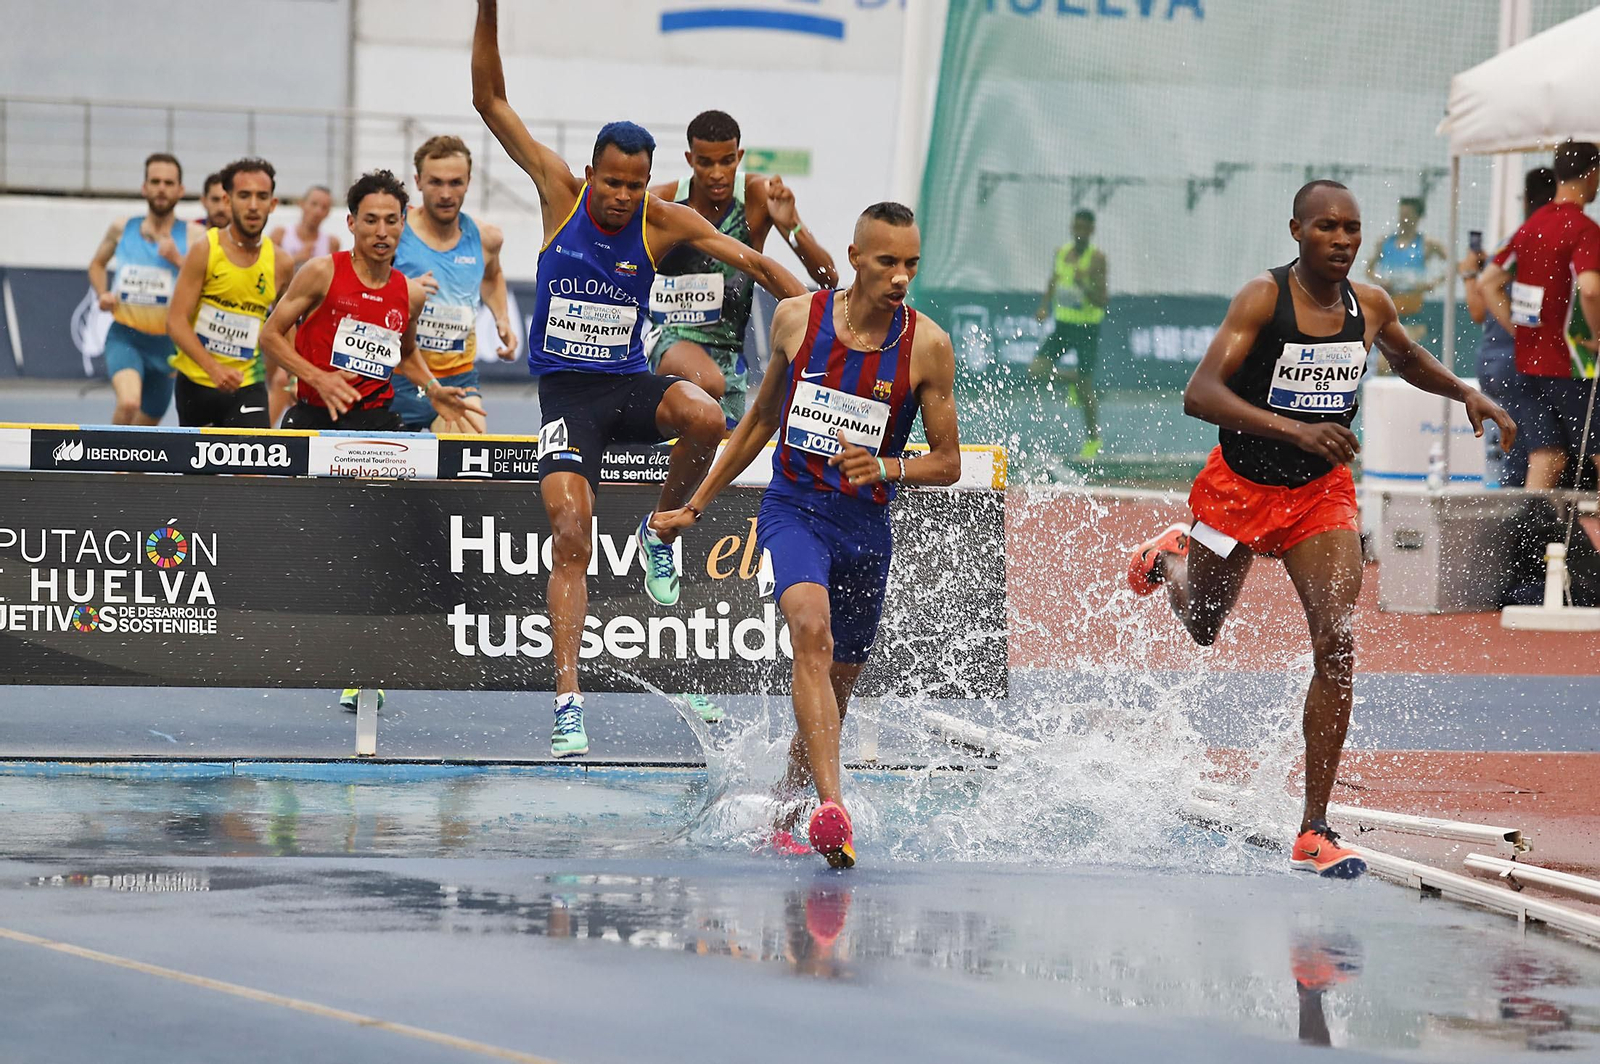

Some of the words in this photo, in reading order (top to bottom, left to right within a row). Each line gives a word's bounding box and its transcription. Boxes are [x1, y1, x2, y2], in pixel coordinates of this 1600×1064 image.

[656, 291, 716, 303] BARROS
[594, 312, 620, 320] HUELVA
[664, 311, 706, 324] Joma
[549, 316, 576, 332] SAN
[580, 323, 630, 336] MARTIN
[585, 334, 598, 344] 71
[345, 336, 391, 358] OUGRA
[561, 341, 612, 359] Joma
[364, 351, 376, 360] 73
[345, 356, 384, 376] Joma
[1278, 366, 1359, 381] KIPSANG
[1315, 381, 1330, 391] 65
[1290, 393, 1345, 408] Joma
[791, 405, 881, 436] ABOUJANAH
[86, 447, 168, 462] IBERDROLA
[190, 442, 292, 469] Joma
[601, 451, 645, 464] Huelva
[494, 461, 510, 473] DE
[513, 462, 539, 473] HUE
[600, 468, 620, 480] tus
[30, 568, 216, 605] HUELVA
[119, 606, 136, 618] DE
[138, 606, 217, 619] DESARROLLO
[118, 618, 217, 634] SOSTENIBLE
[447, 602, 553, 658] tus
